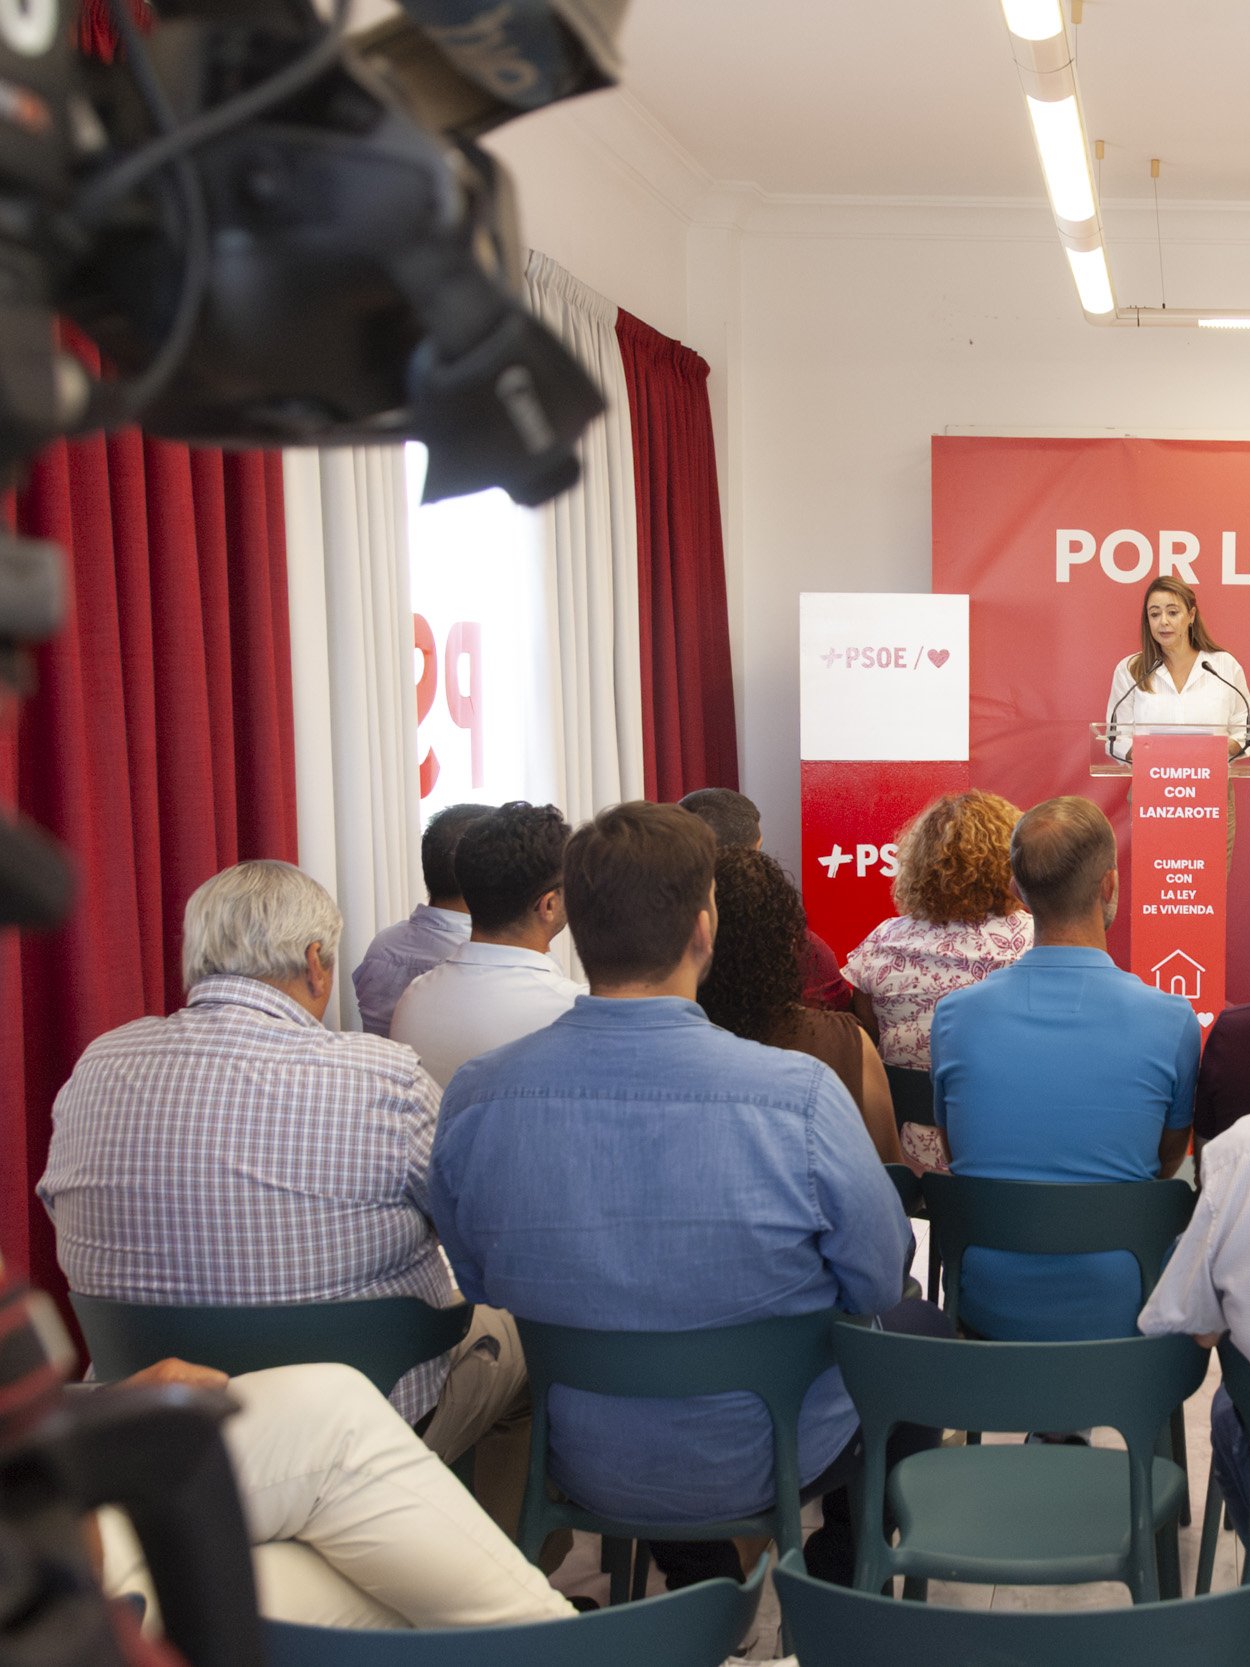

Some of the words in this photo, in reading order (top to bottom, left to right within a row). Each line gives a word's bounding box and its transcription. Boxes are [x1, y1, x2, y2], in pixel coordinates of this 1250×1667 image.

[1056, 529, 1200, 584] POR
[1149, 767, 1210, 779] CUMPLIR
[1164, 786, 1196, 798] CON
[1139, 806, 1220, 818] LANZAROTE
[1153, 859, 1205, 870] CUMPLIR
[1165, 874, 1192, 884] CON
[1161, 890, 1175, 900] LA
[1177, 890, 1197, 900] LEY
[1142, 904, 1157, 914] DE
[1159, 904, 1214, 915] VIVIENDA
